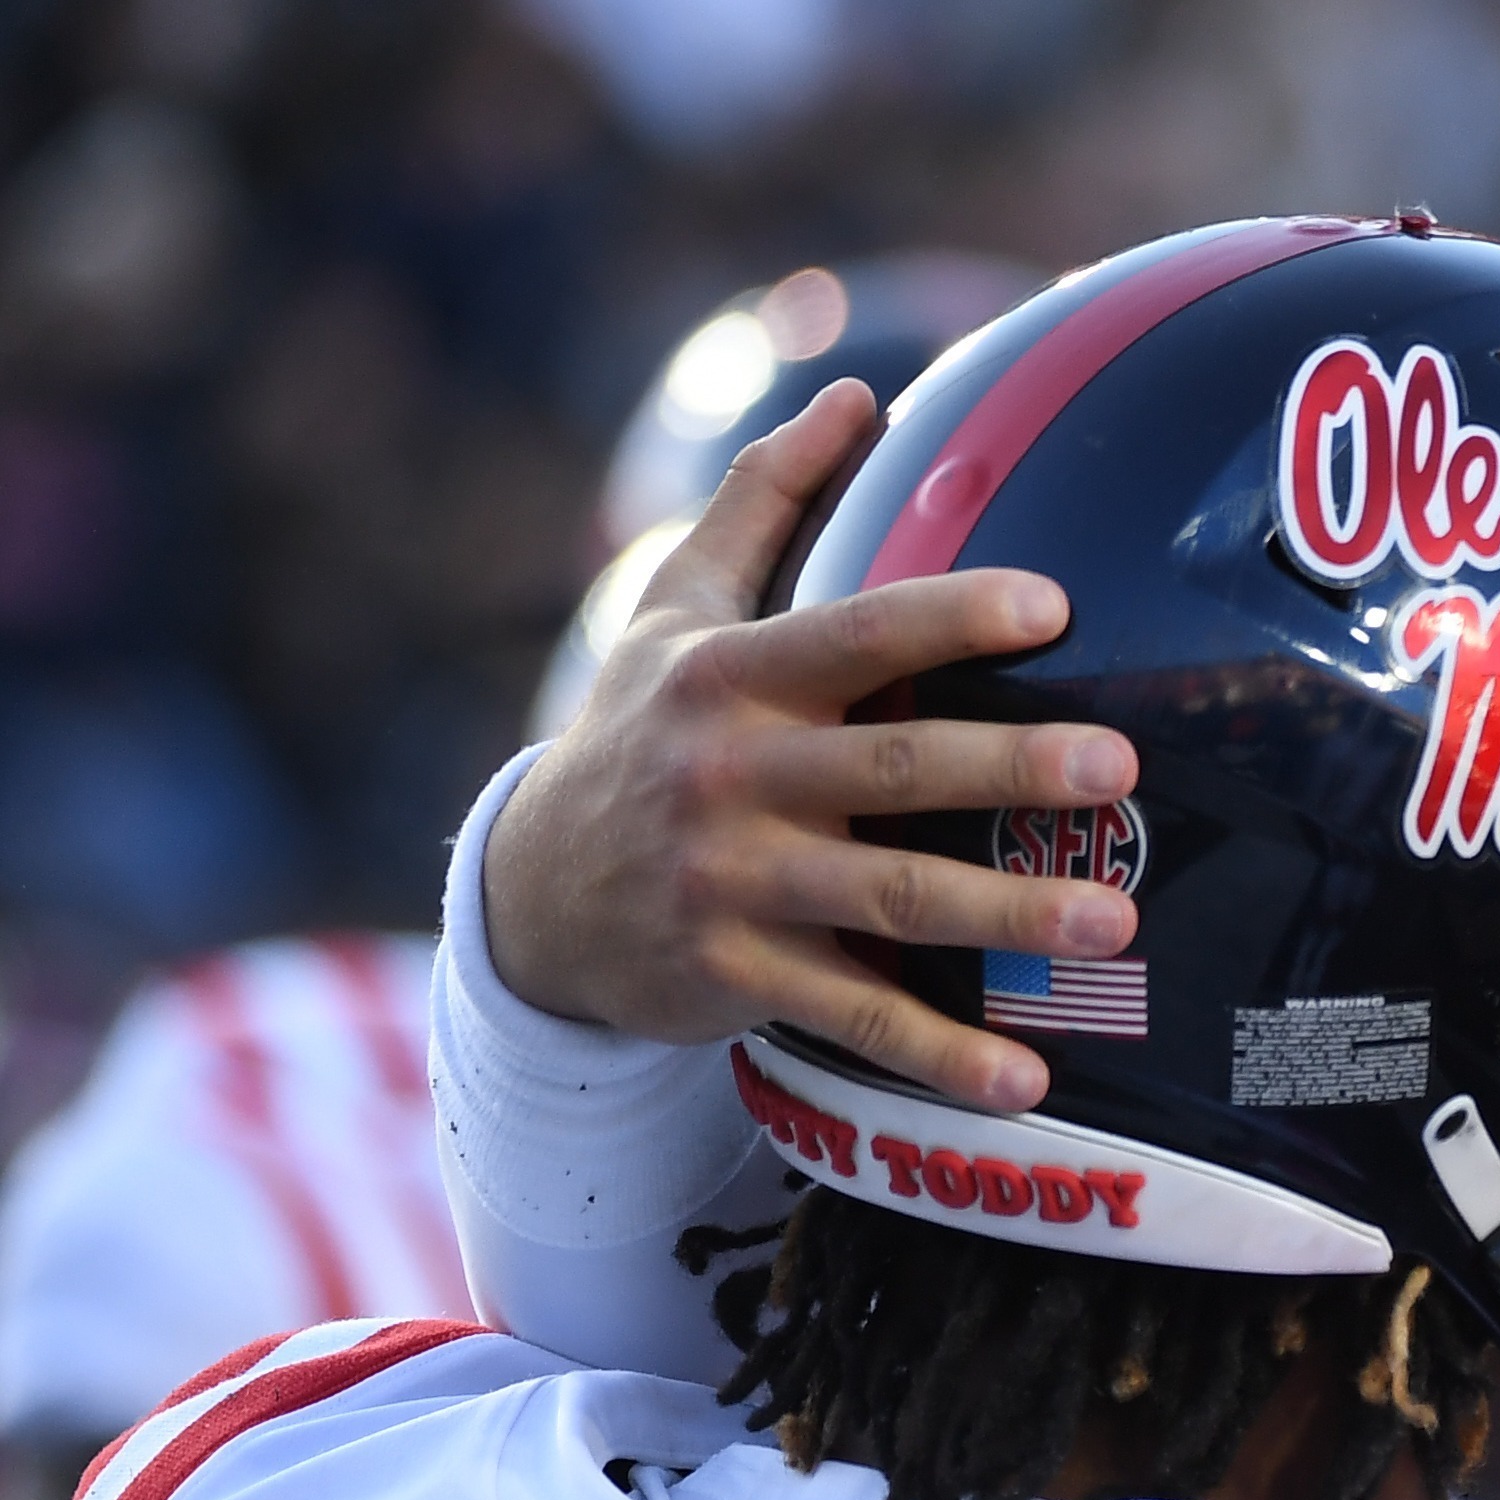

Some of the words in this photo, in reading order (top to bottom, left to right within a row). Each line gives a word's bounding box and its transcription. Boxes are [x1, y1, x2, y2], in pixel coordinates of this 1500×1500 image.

[1008, 802, 1133, 887] SEC
[1285, 996, 1385, 1009] WARNING
[730, 1041, 858, 1178] TTY
[871, 1135, 1146, 1229] TODDY
